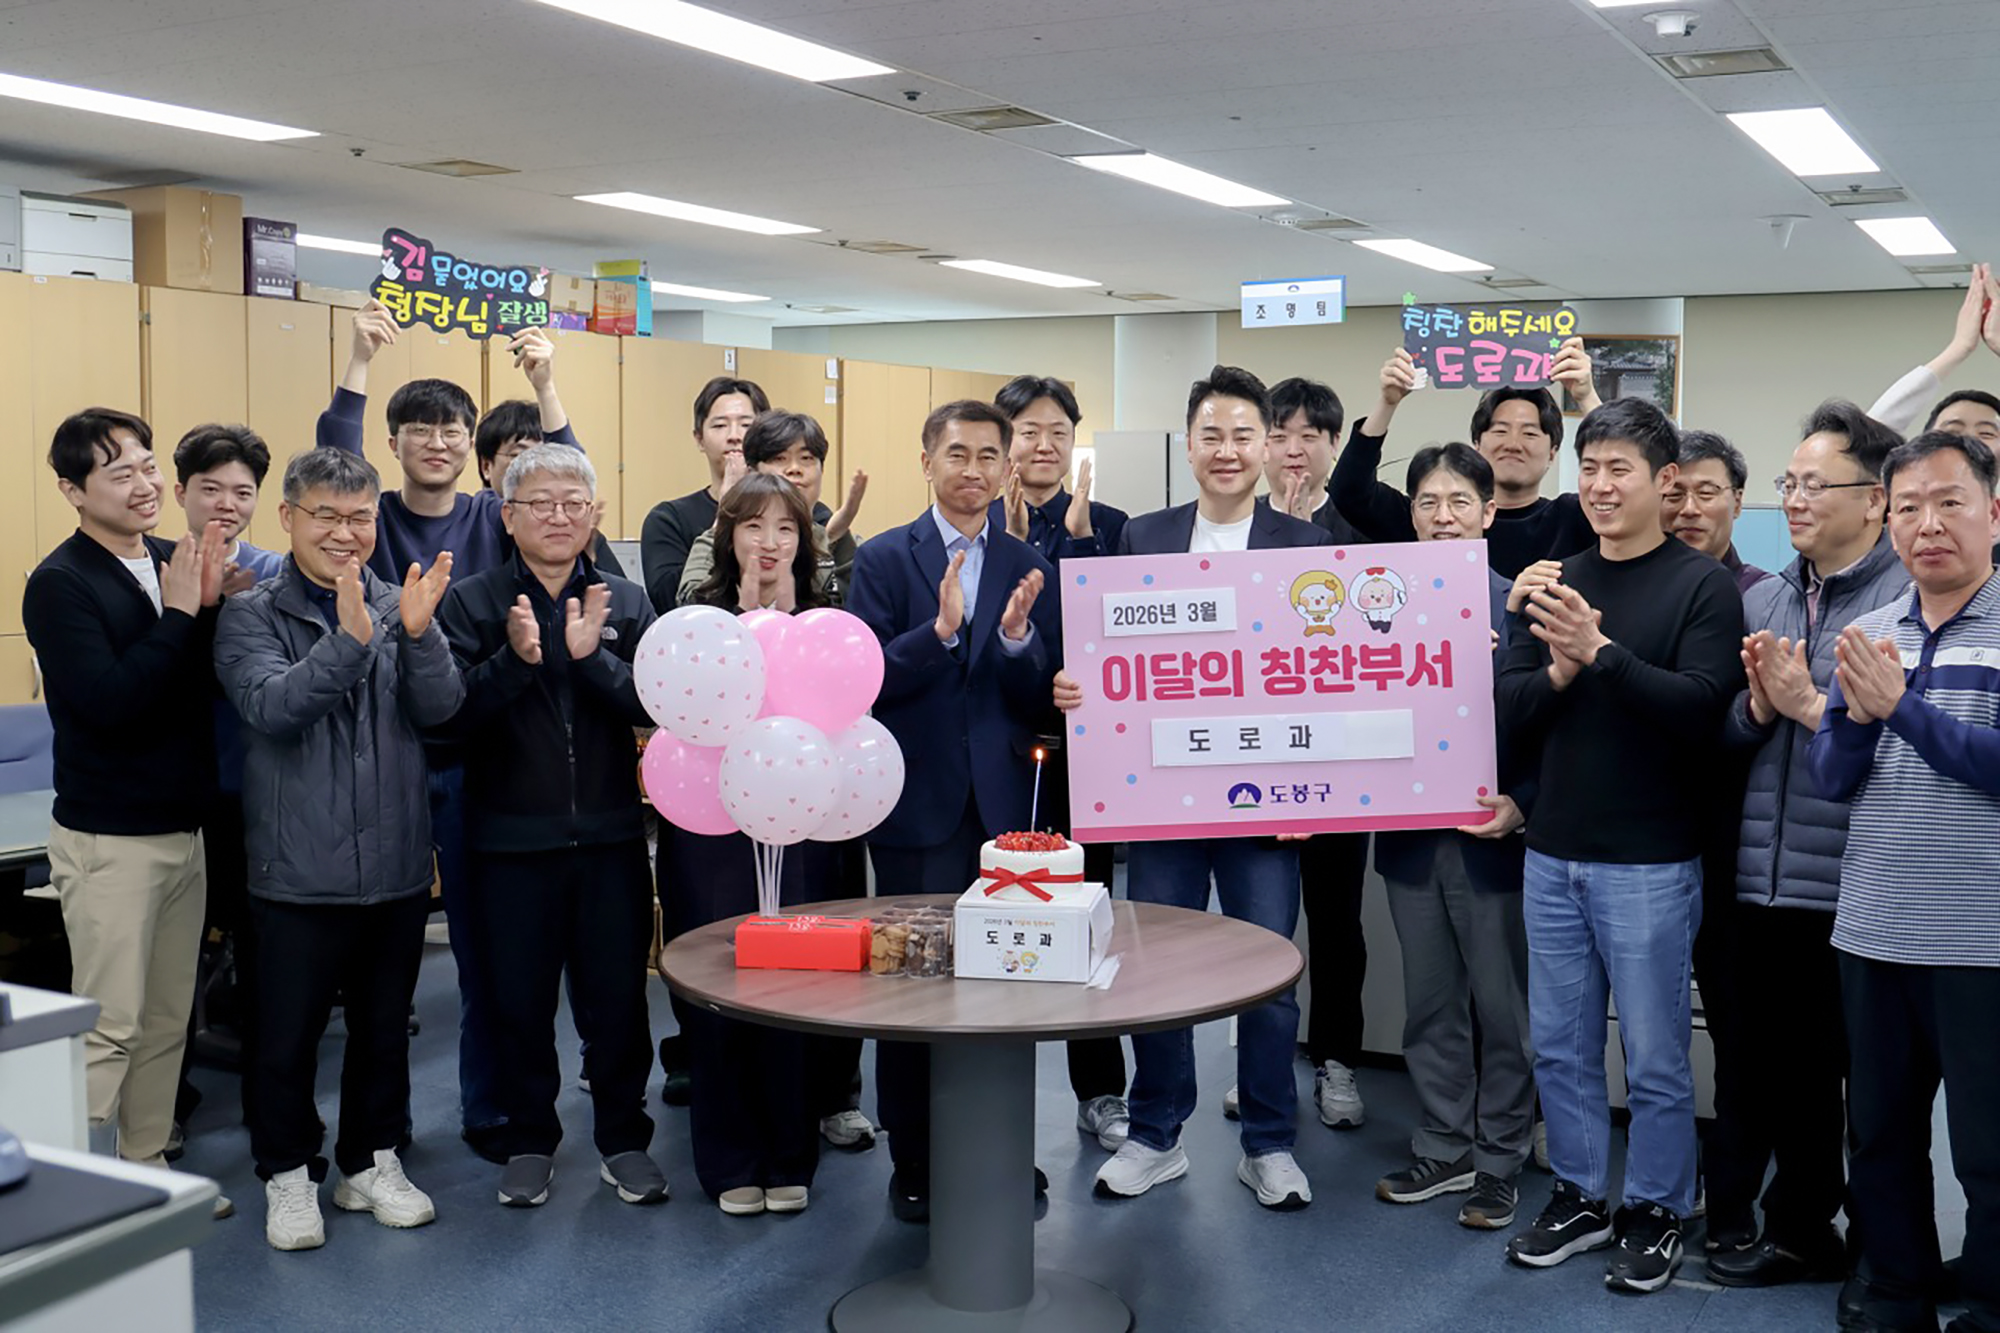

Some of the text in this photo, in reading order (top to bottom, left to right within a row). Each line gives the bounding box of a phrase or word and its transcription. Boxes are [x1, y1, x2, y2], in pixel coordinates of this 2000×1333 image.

[391, 234, 528, 293] 김 묻었어요
[498, 300, 549, 325] 잘생
[1403, 307, 1575, 338] 칭찬 해주세요
[1435, 340, 1552, 382] 도로과
[1113, 601, 1218, 626] 2026년 3월
[1102, 639, 1454, 702] 이달의 칭찬부서
[1269, 782, 1332, 804] 도봉구
